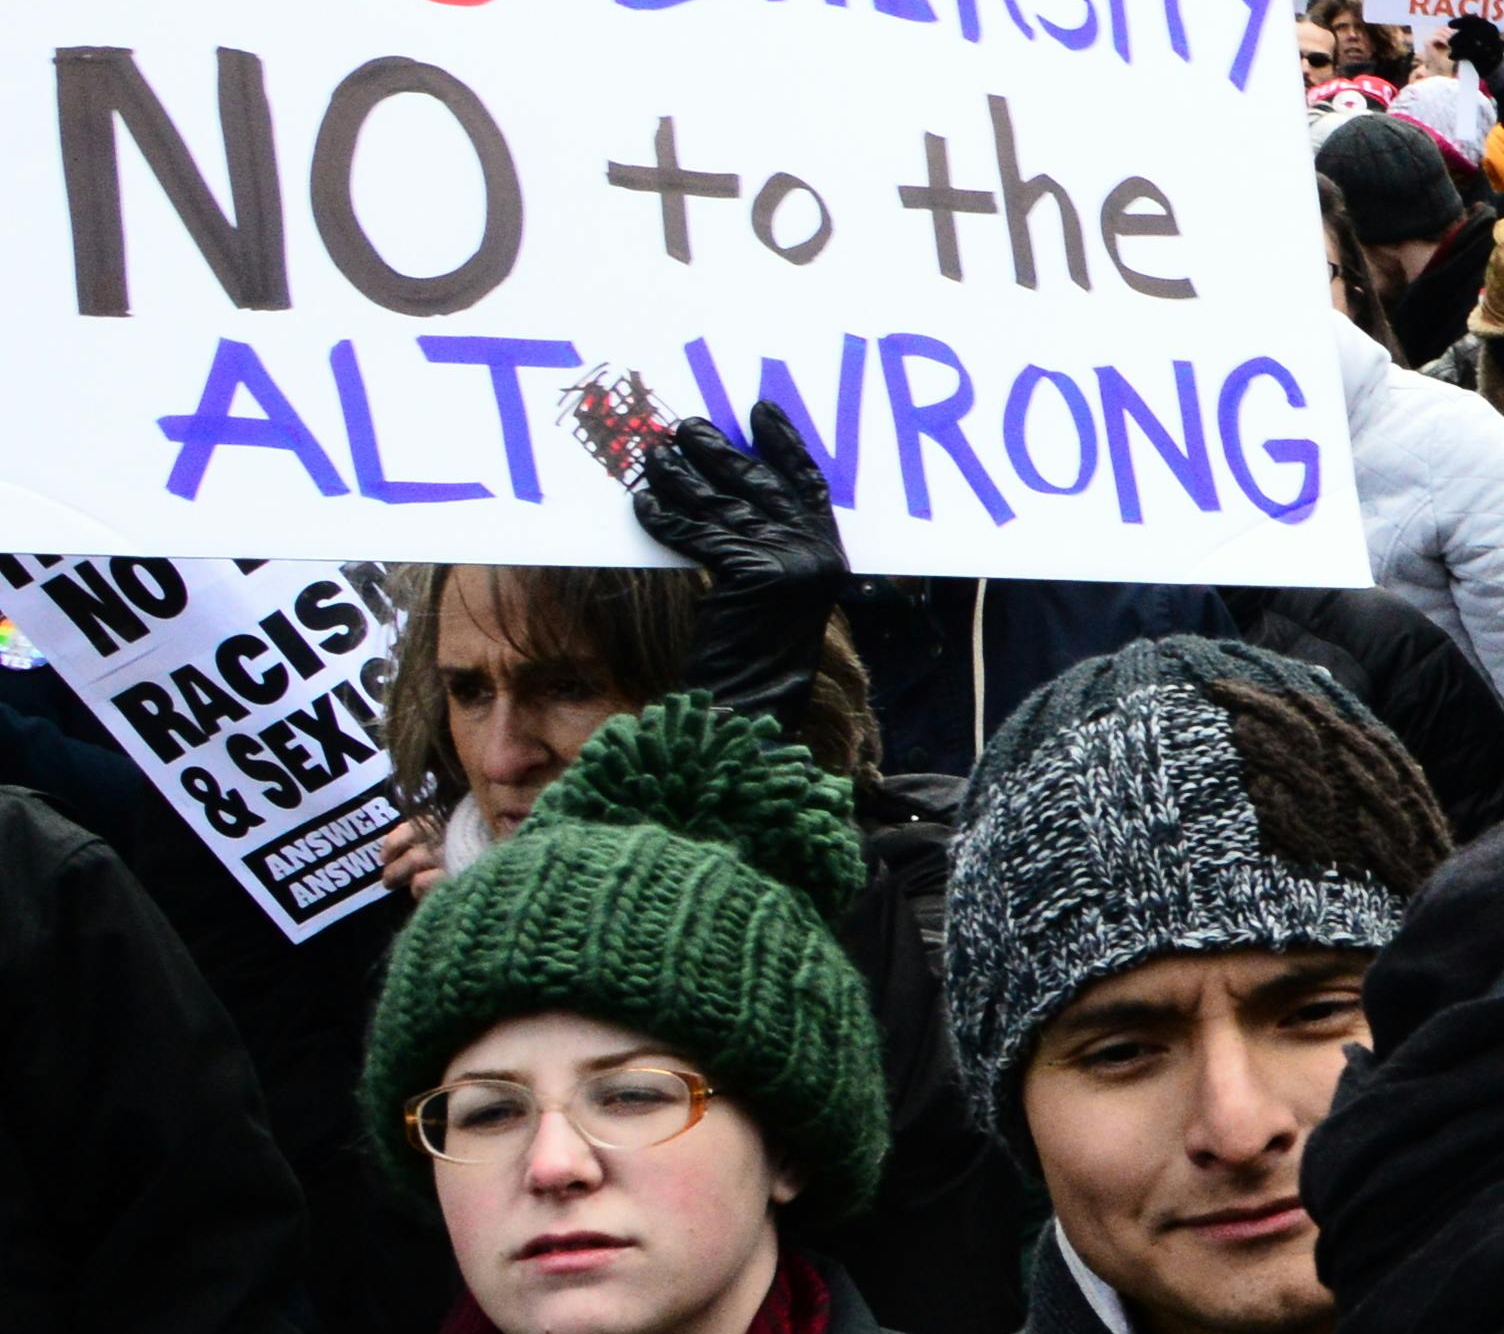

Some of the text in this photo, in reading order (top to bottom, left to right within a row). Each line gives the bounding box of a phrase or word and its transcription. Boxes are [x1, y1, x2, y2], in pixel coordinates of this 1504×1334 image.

[55, 46, 1199, 317] NO to the
[159, 333, 1321, 525] ALT WRONG
[42, 556, 188, 657] NO
[180, 767, 266, 838] &
[266, 797, 400, 882] ANSWER
